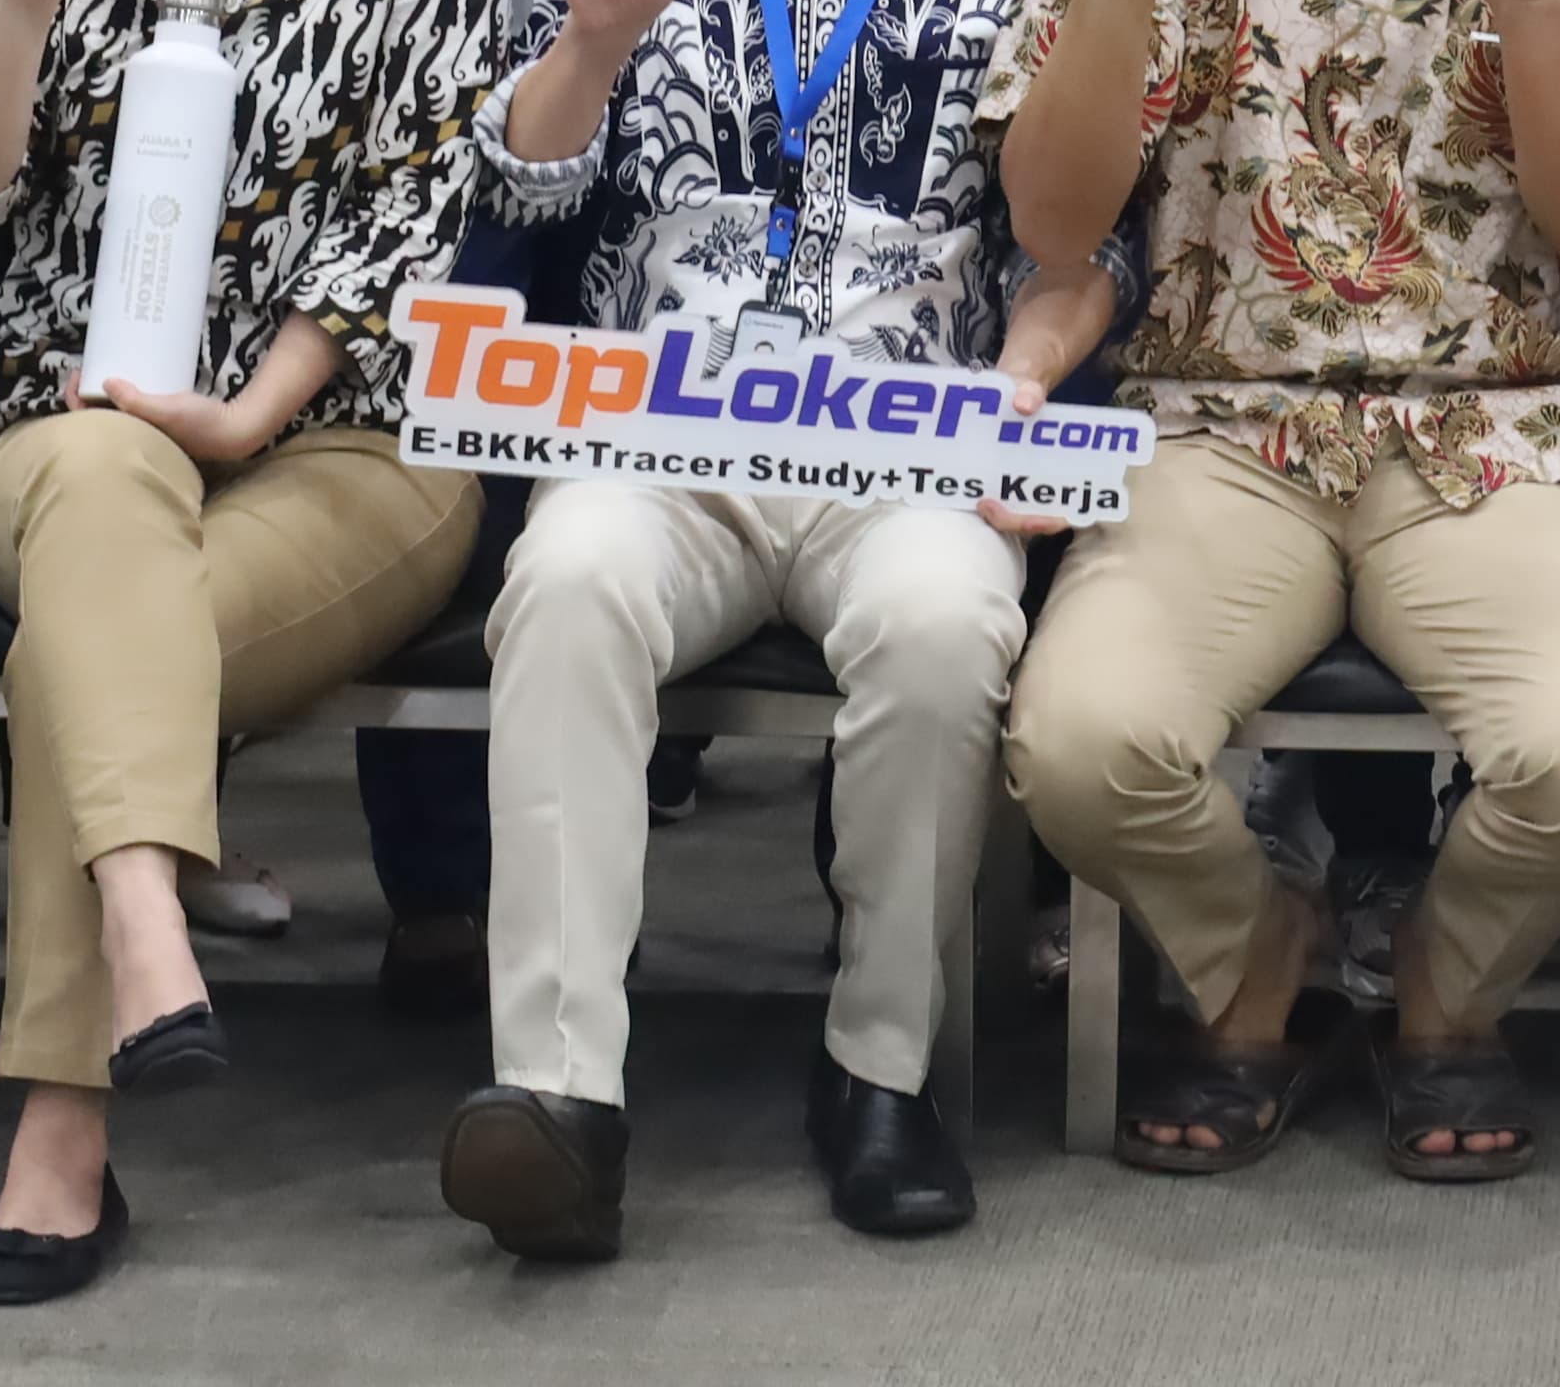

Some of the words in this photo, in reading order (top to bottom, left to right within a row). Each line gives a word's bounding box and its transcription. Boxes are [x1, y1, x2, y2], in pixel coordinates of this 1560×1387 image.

[408, 297, 1139, 454] TopLoker.com
[410, 427, 735, 478] E-BKK+Tracer
[747, 453, 985, 502] Study+Tes
[1000, 474, 1121, 514] Kerja
